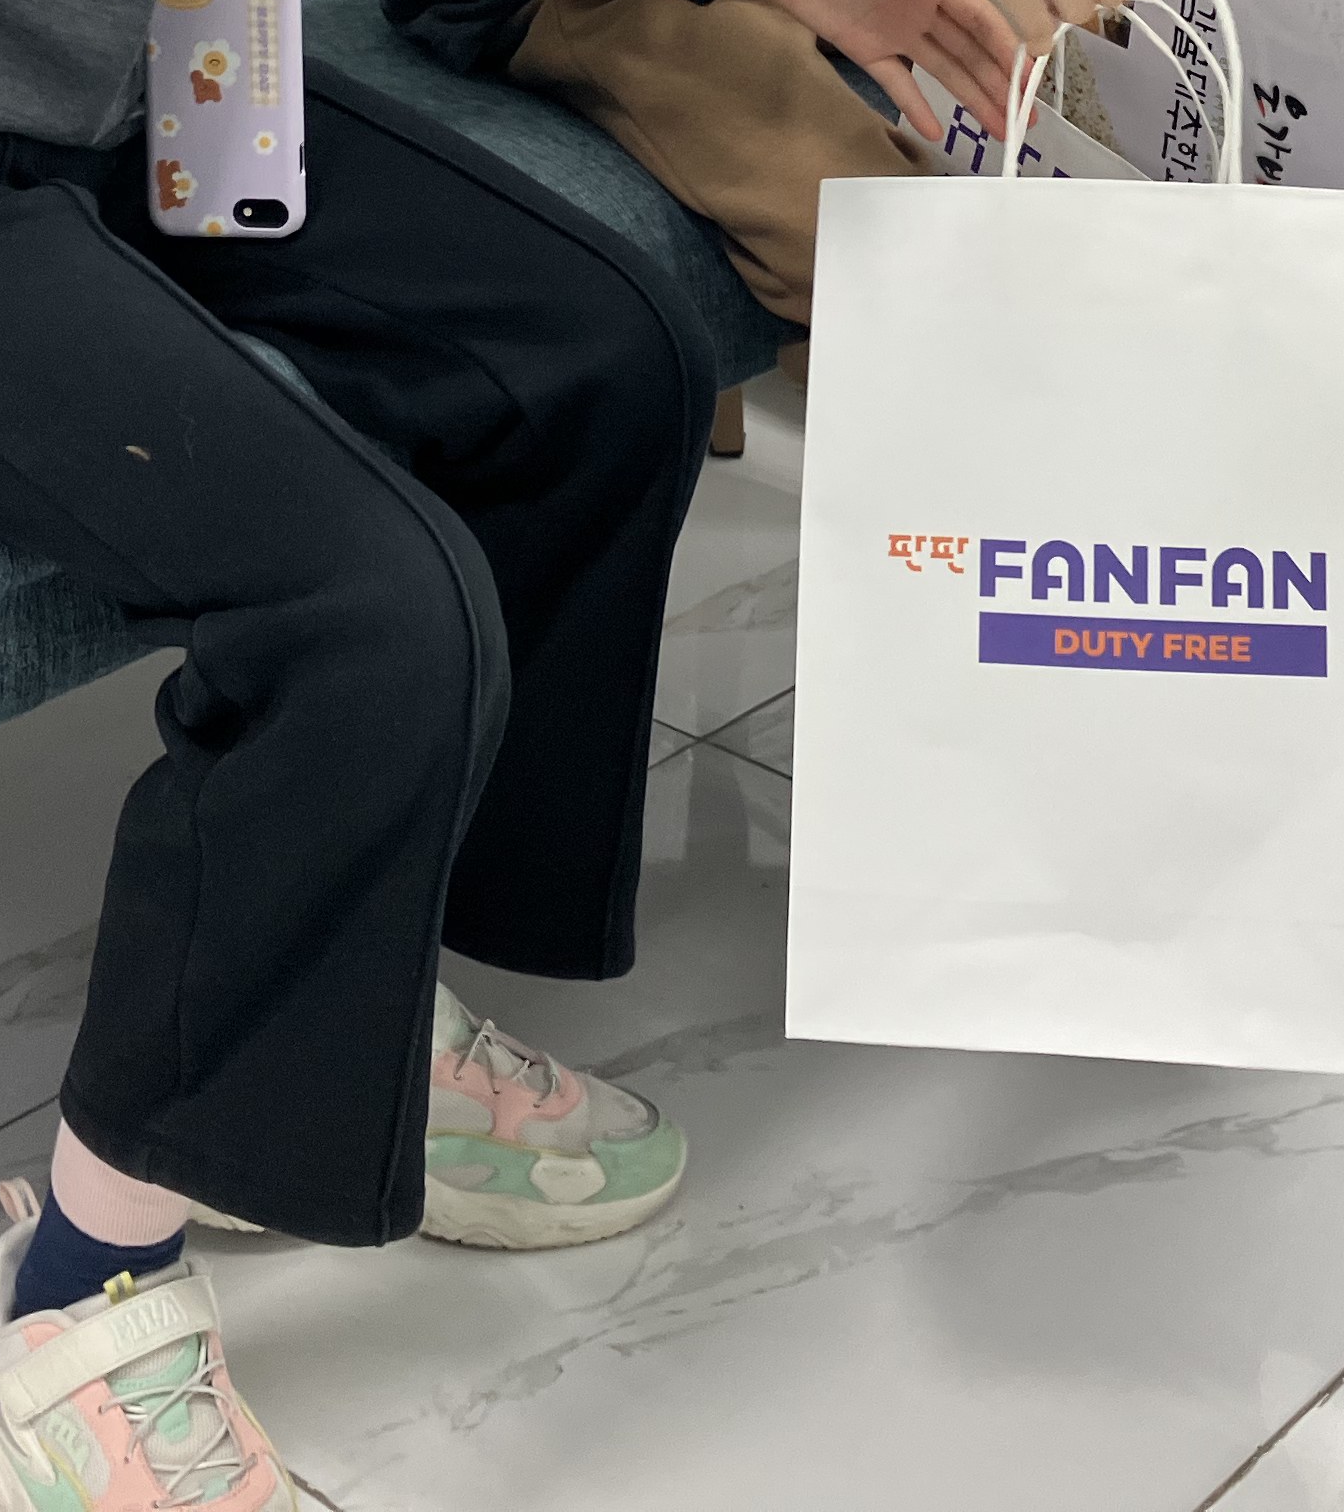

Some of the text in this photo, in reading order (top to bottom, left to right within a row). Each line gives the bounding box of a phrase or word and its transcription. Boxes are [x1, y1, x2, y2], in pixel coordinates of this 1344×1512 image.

[979, 538, 1328, 612] FANFAN
[1054, 628, 1253, 663] DUTY FREE
